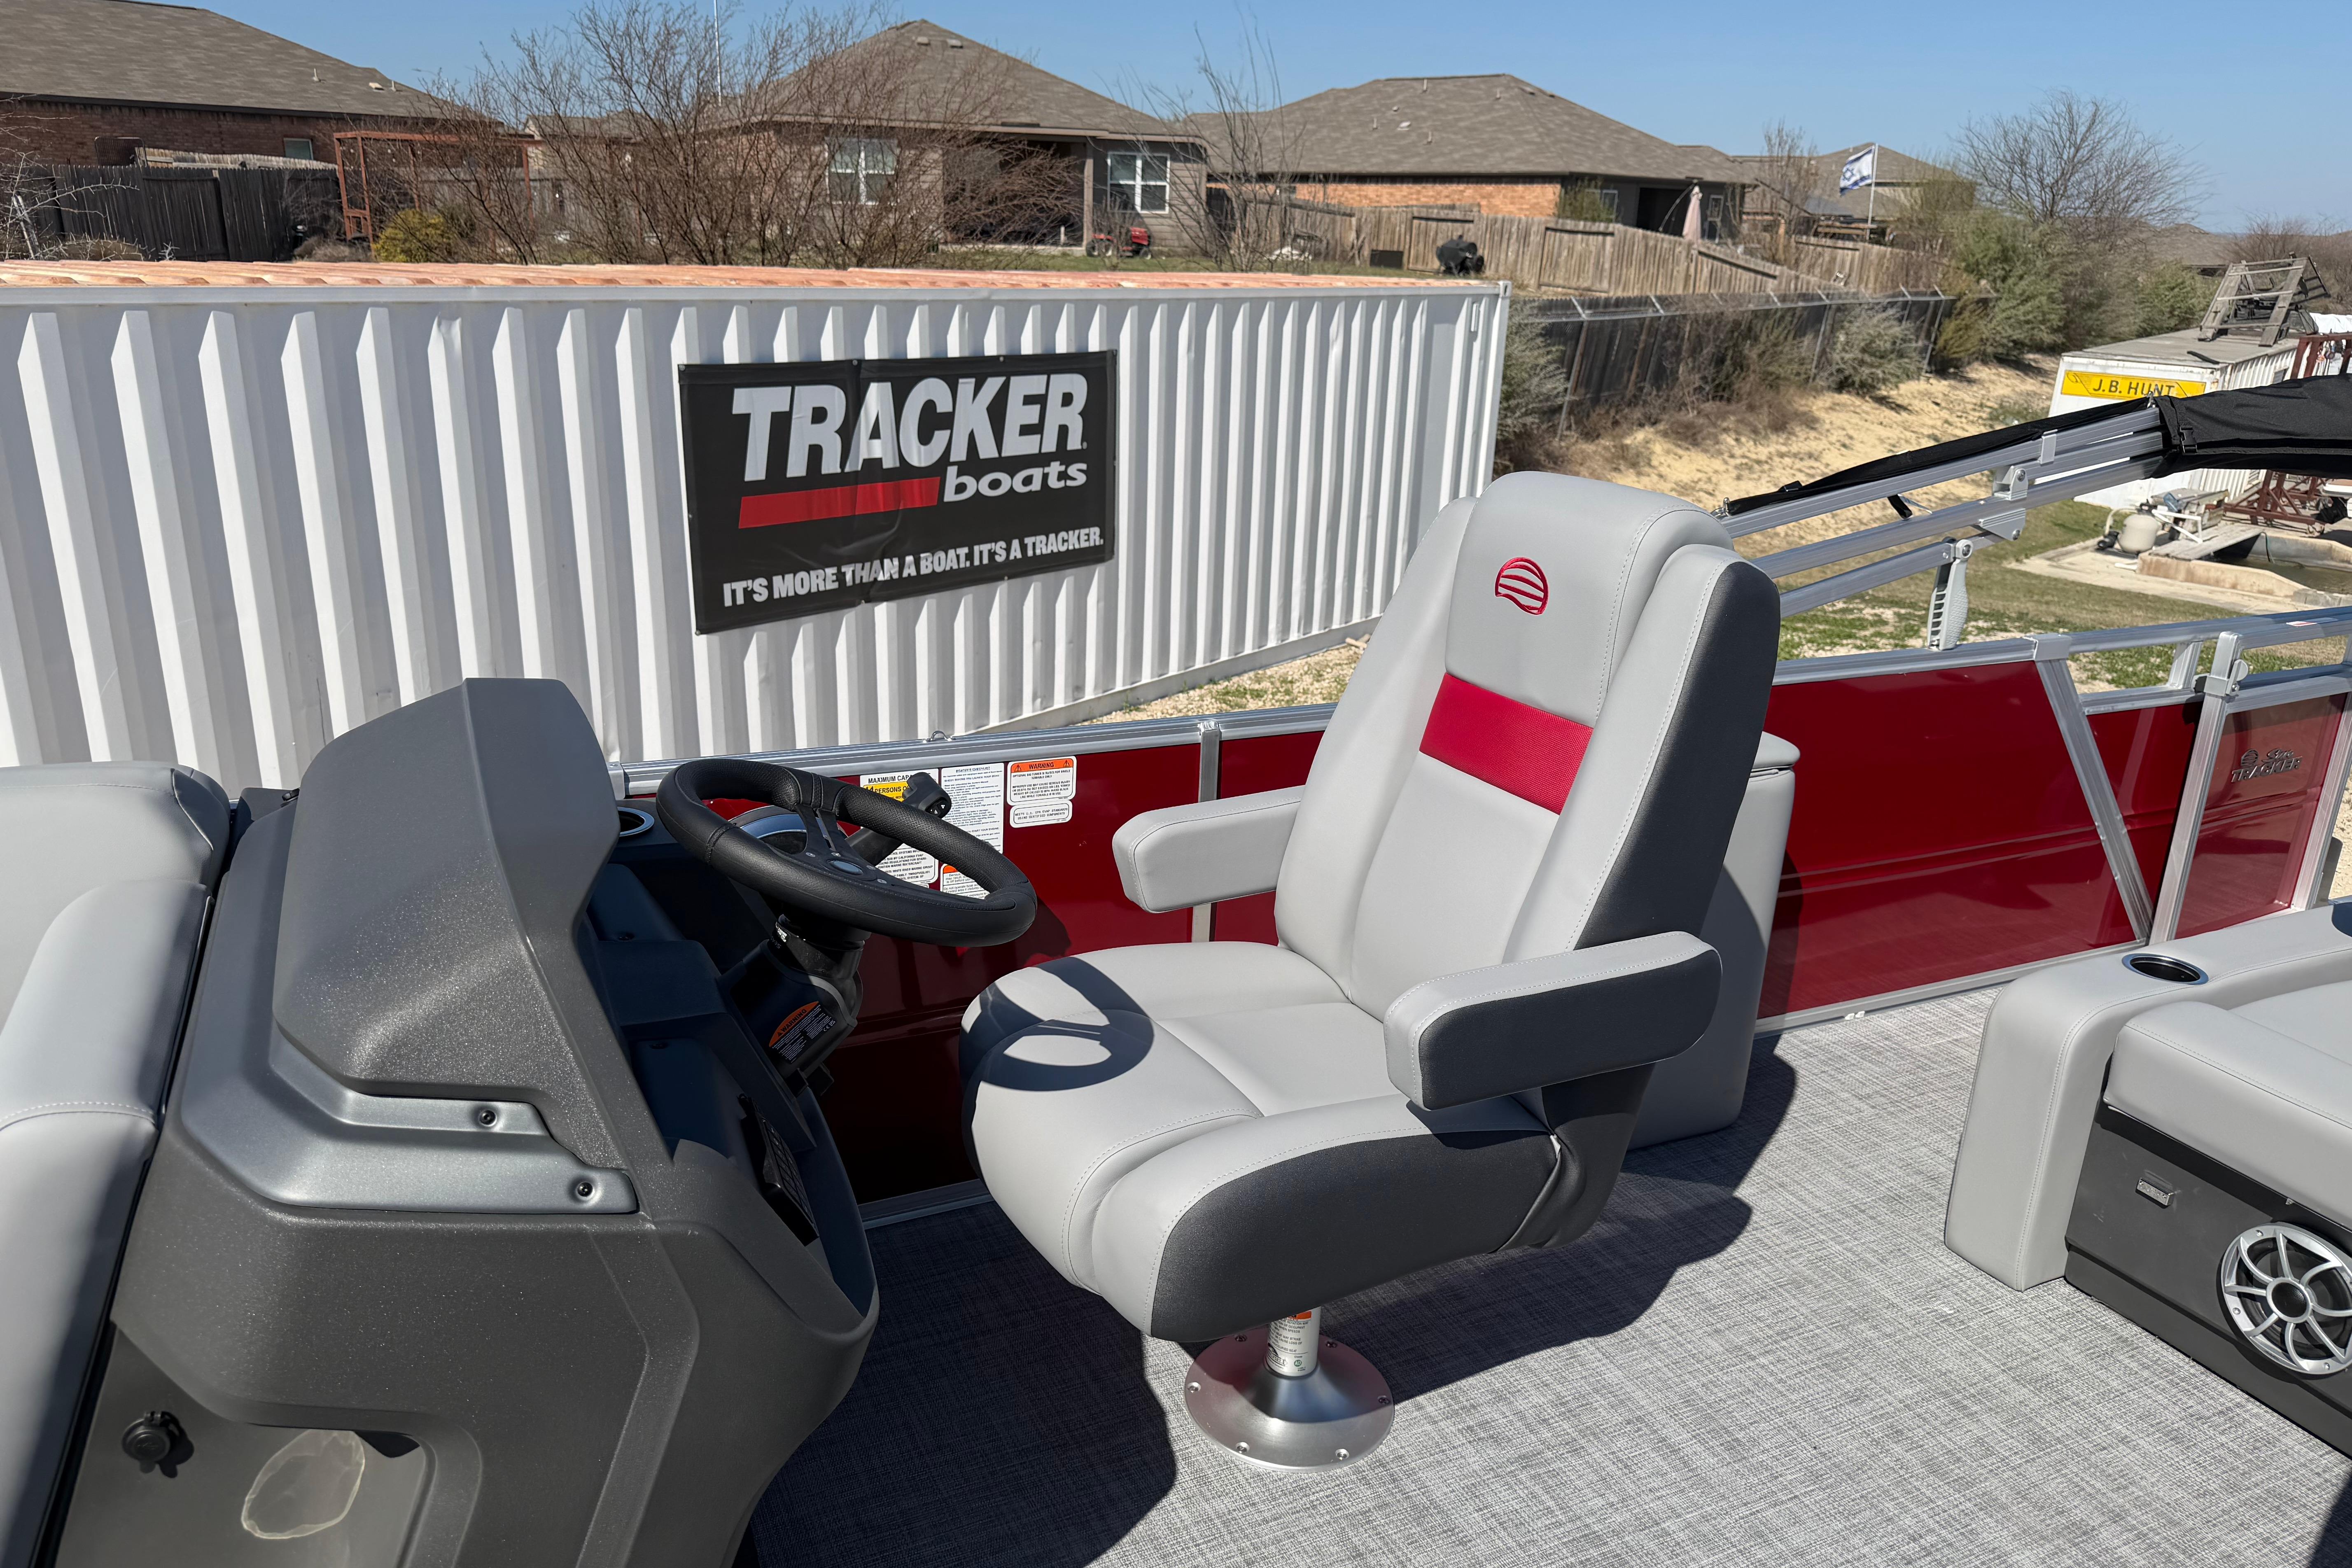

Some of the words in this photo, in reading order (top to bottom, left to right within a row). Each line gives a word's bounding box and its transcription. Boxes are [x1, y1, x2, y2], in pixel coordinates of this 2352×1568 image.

[2127, 381, 2175, 396] HUNT
[732, 373, 1088, 481] TRACKER
[943, 460, 1088, 502] boats
[723, 580, 769, 607] IT'S
[773, 567, 839, 600] MORE
[842, 557, 898, 587] THAN
[902, 555, 917, 577] A
[920, 547, 970, 576] BOAT.
[973, 541, 1007, 566] IT'S
[1009, 540, 1022, 559] A
[1024, 527, 1104, 555] TRACKER.
[2231, 756, 2303, 783] TRACKER
[782, 1009, 807, 1033] WARNING
